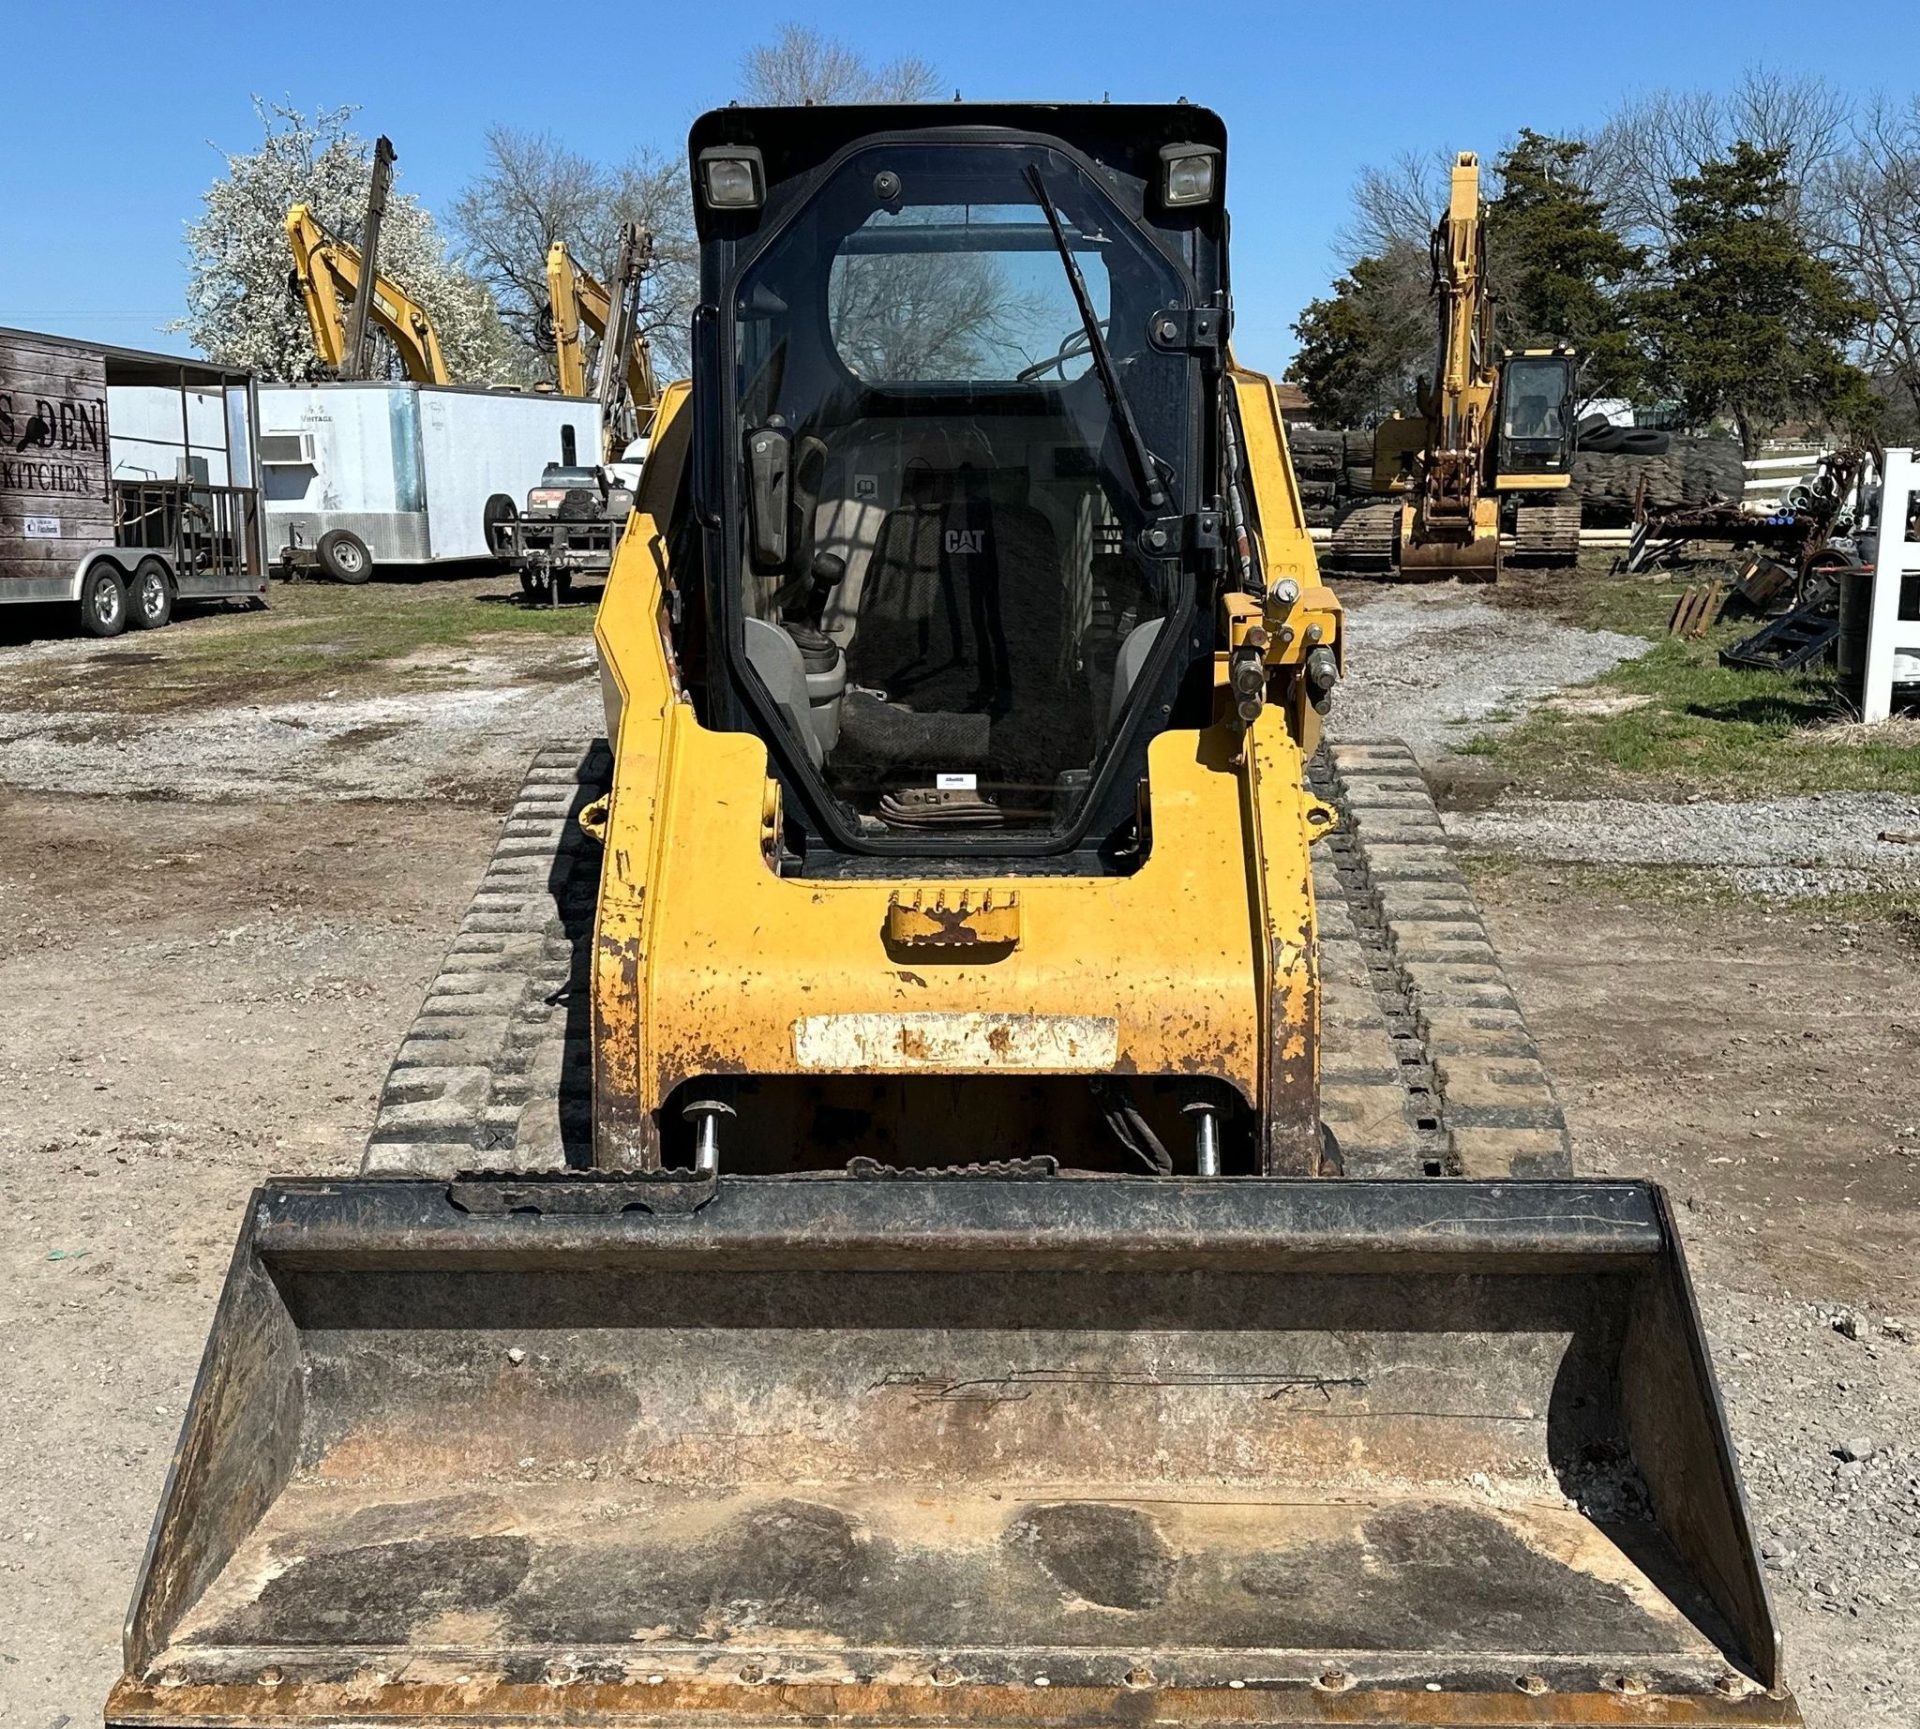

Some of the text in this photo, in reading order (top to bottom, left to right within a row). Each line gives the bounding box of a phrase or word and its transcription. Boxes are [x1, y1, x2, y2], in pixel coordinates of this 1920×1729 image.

[35, 399, 98, 452] DEN
[2, 461, 89, 492] KITCHEN
[945, 530, 985, 554] CAT
